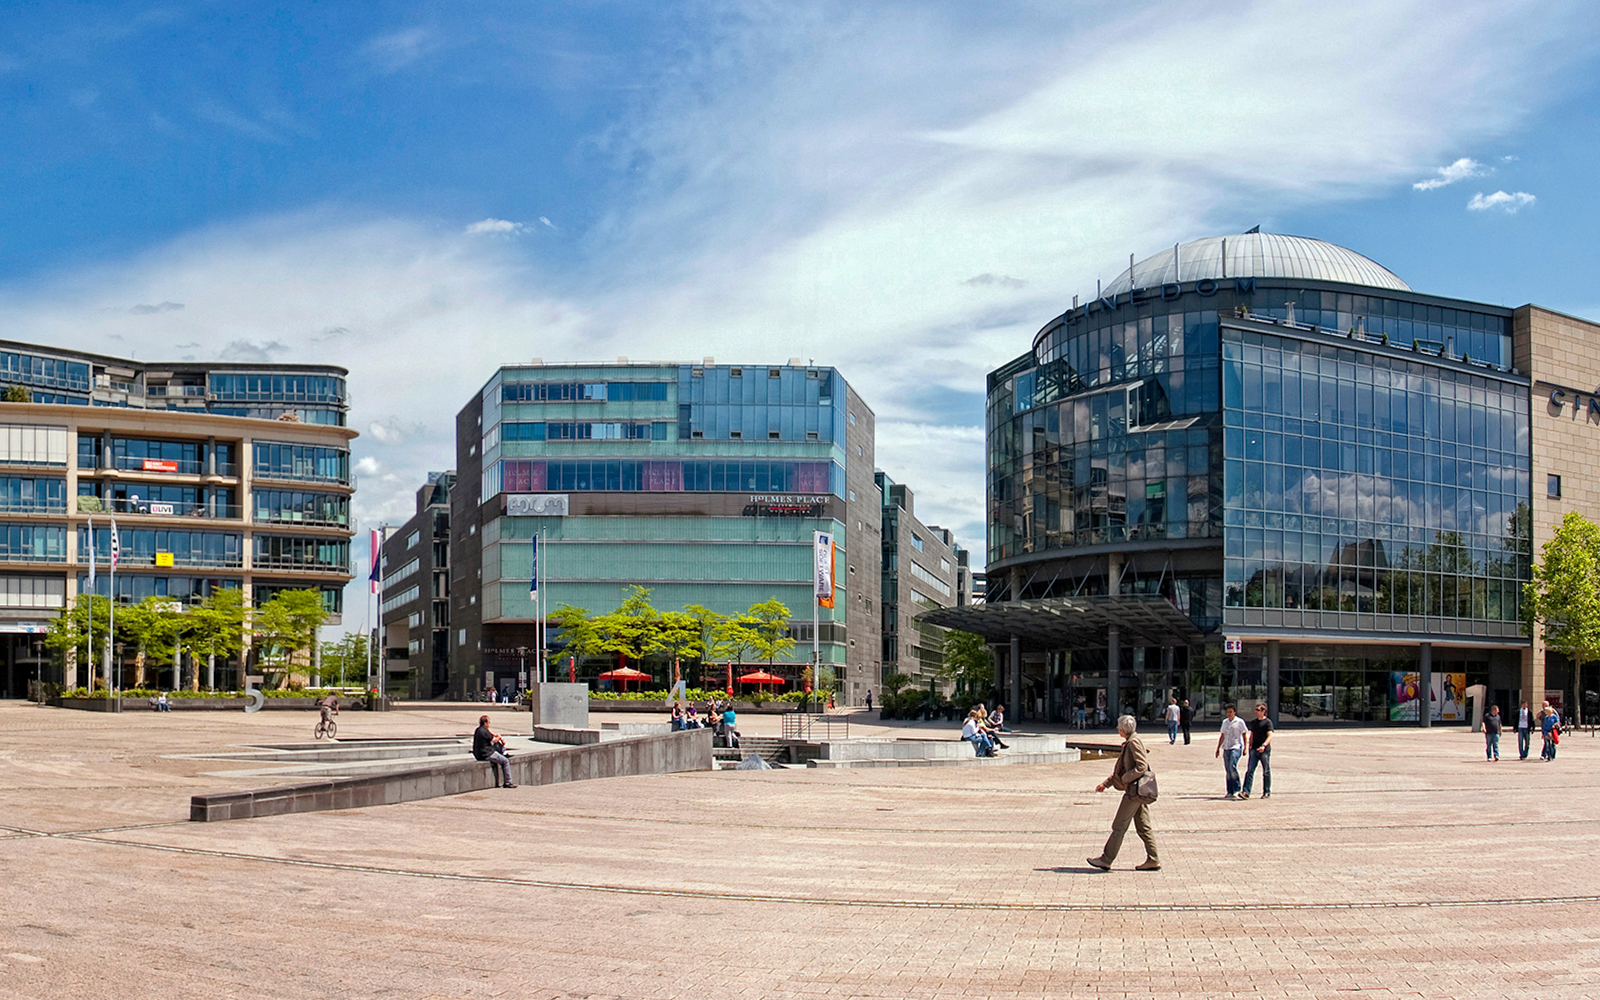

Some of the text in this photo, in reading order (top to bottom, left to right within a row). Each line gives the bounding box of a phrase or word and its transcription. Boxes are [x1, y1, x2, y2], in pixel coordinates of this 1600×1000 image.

[1063, 276, 1257, 326] CINEDOM
[750, 495, 830, 504] HOLMES PLACE
[245, 675, 265, 713] 5
[665, 680, 690, 714] 4
[1465, 683, 1487, 732] 1
